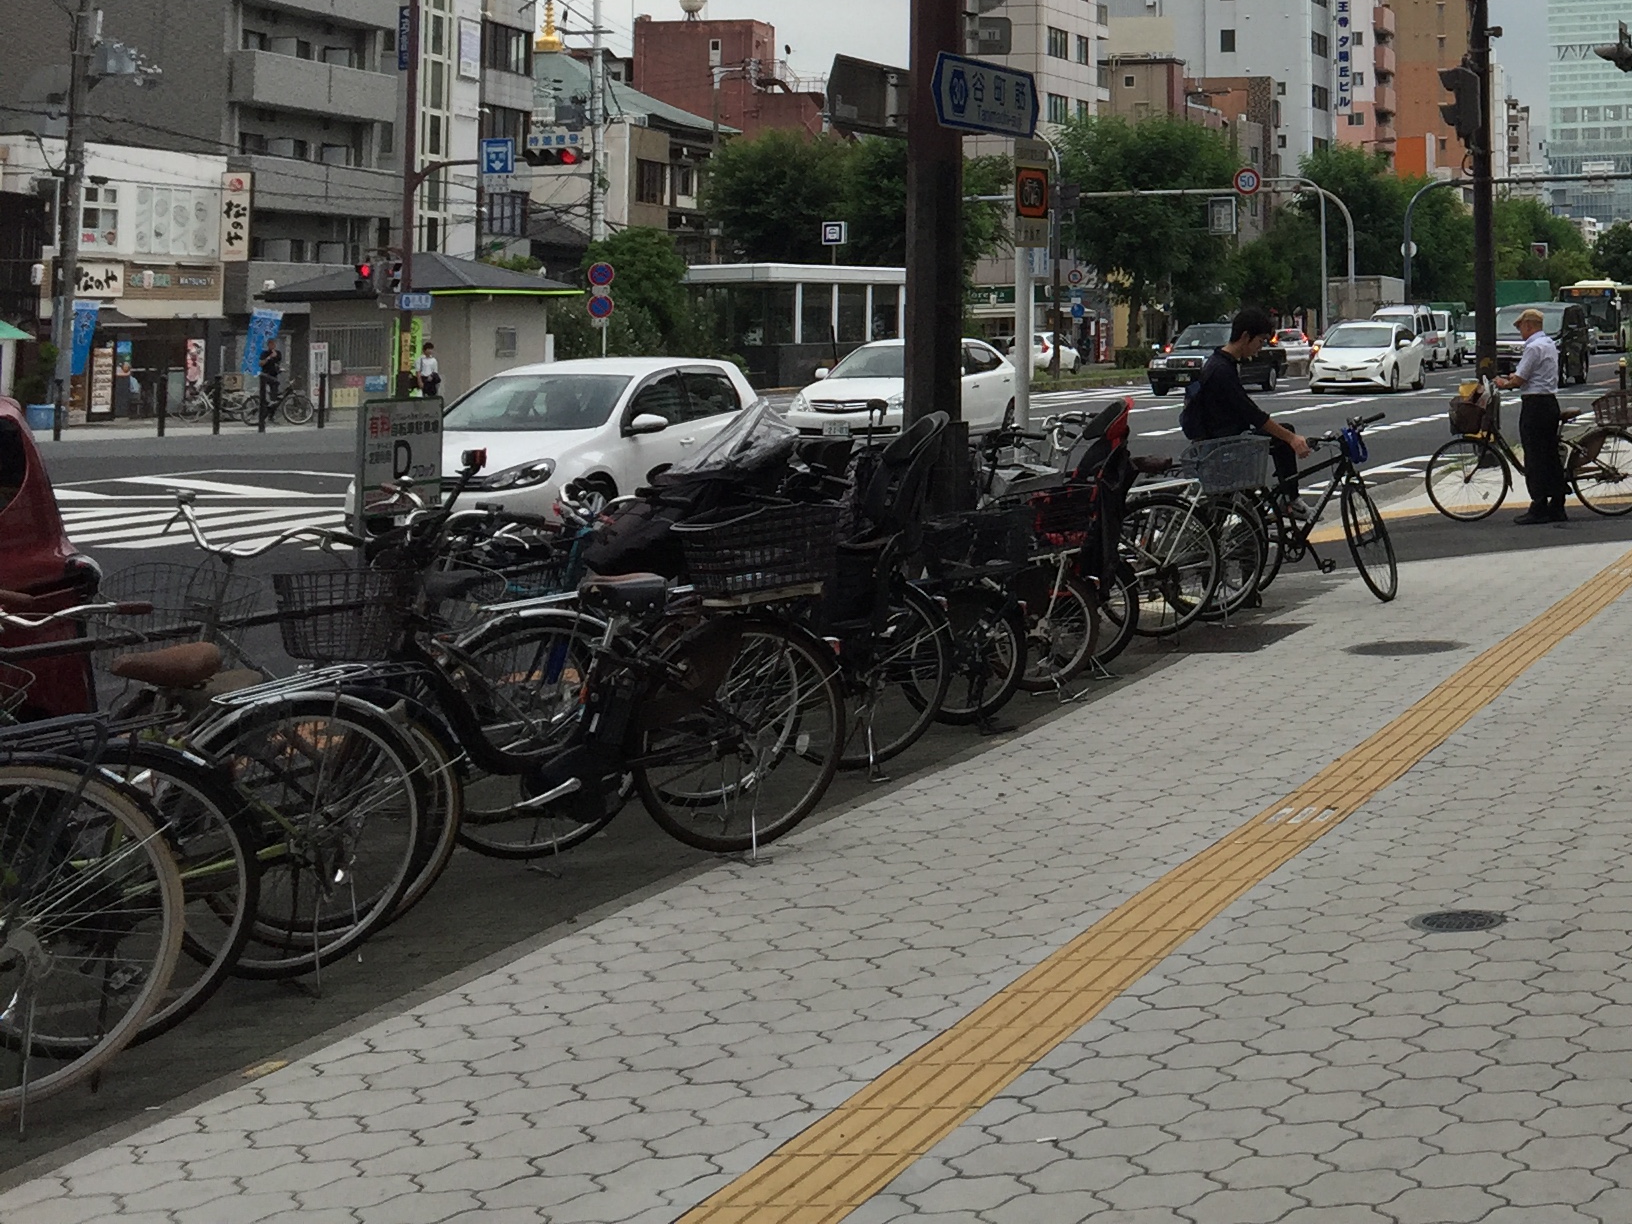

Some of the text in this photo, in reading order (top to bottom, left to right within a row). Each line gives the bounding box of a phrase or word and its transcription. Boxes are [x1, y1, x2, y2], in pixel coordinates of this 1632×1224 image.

[953, 77, 965, 106] 30
[972, 71, 1027, 111] 谷町筋
[1240, 175, 1255, 188] 50
[223, 200, 247, 247] 松のや
[368, 416, 391, 438] 有料
[393, 439, 412, 480] D
